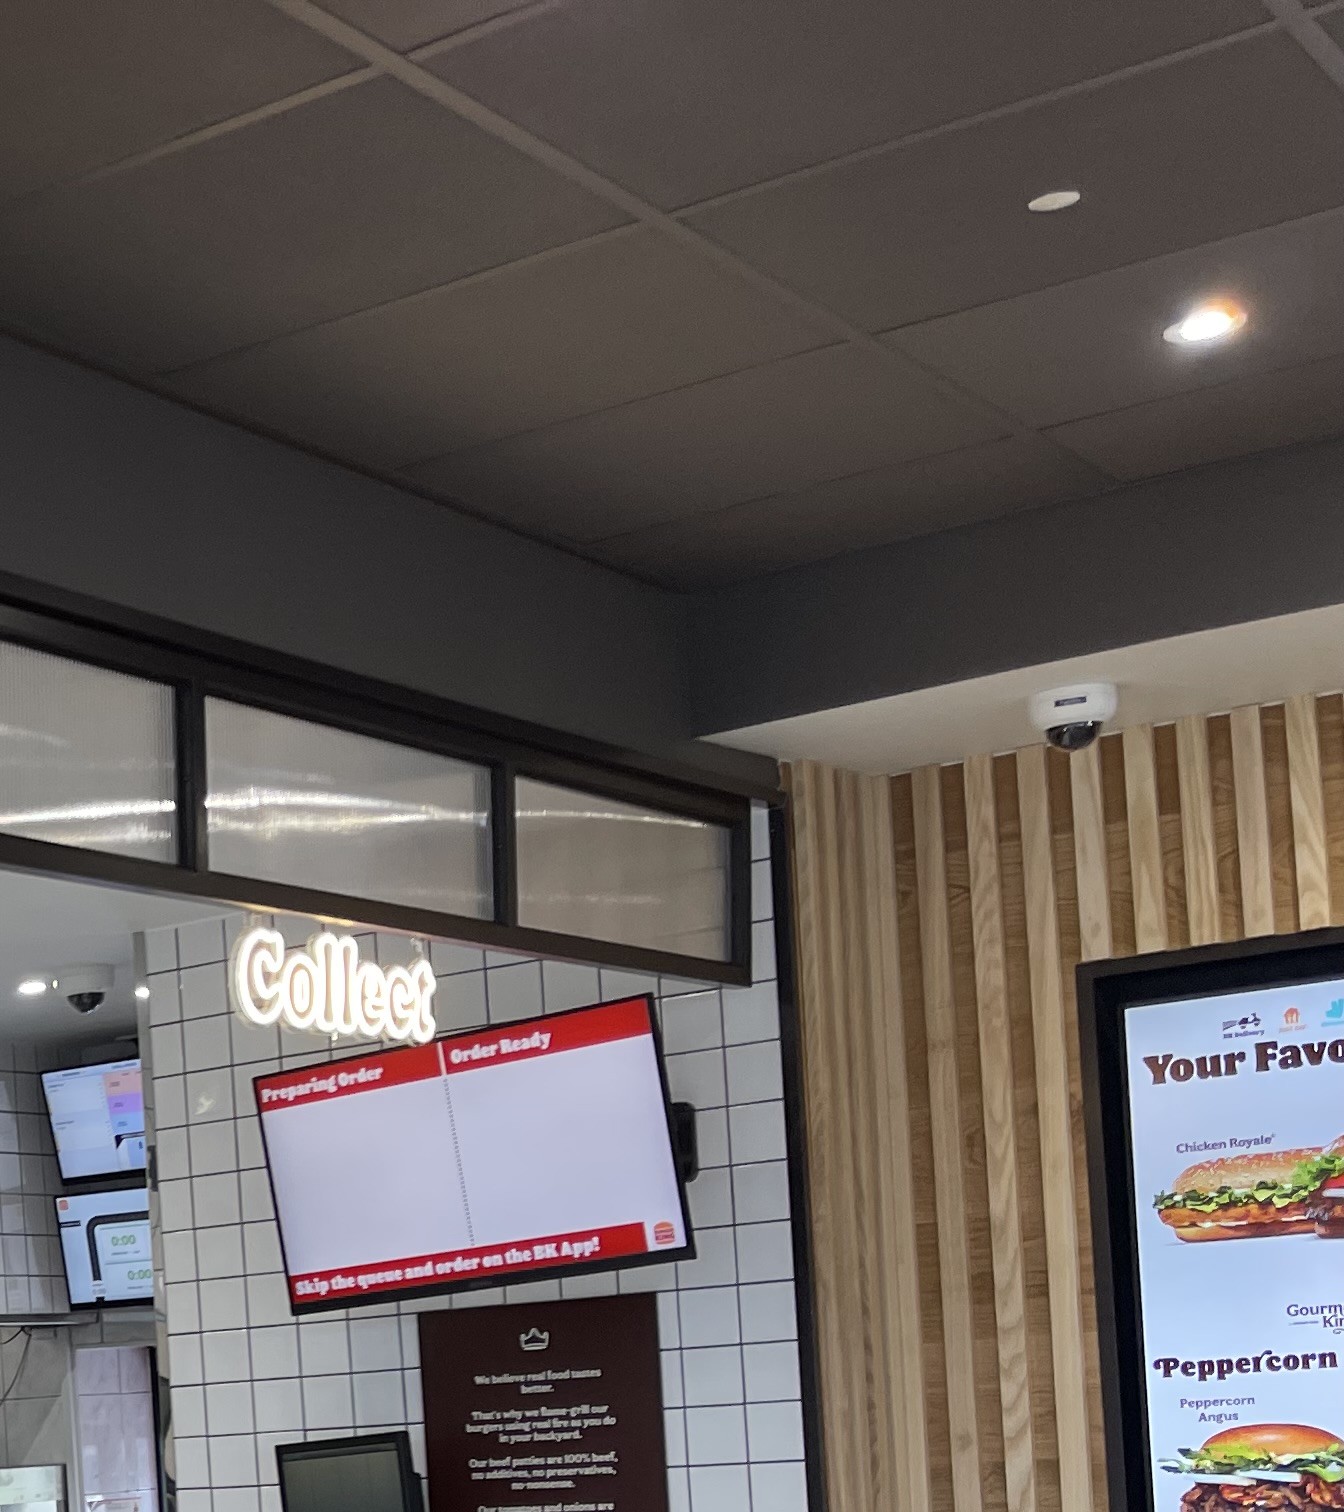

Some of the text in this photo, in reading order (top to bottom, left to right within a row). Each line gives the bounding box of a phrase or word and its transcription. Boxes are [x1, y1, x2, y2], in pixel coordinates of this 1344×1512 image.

[236, 928, 436, 1043] Collect
[450, 1031, 552, 1064] Order Ready
[1143, 1051, 1247, 1085] Your
[261, 1066, 384, 1103] Preparing Order
[1176, 1140, 1227, 1154] Chicken
[295, 1236, 601, 1296] Skip the queue and order on the BK App!
[1153, 1350, 1339, 1381] Peppercorn
[1179, 1397, 1256, 1410] Peppercorn
[1198, 1412, 1239, 1424] Angus
[564, 1453, 591, 1463] 100%
